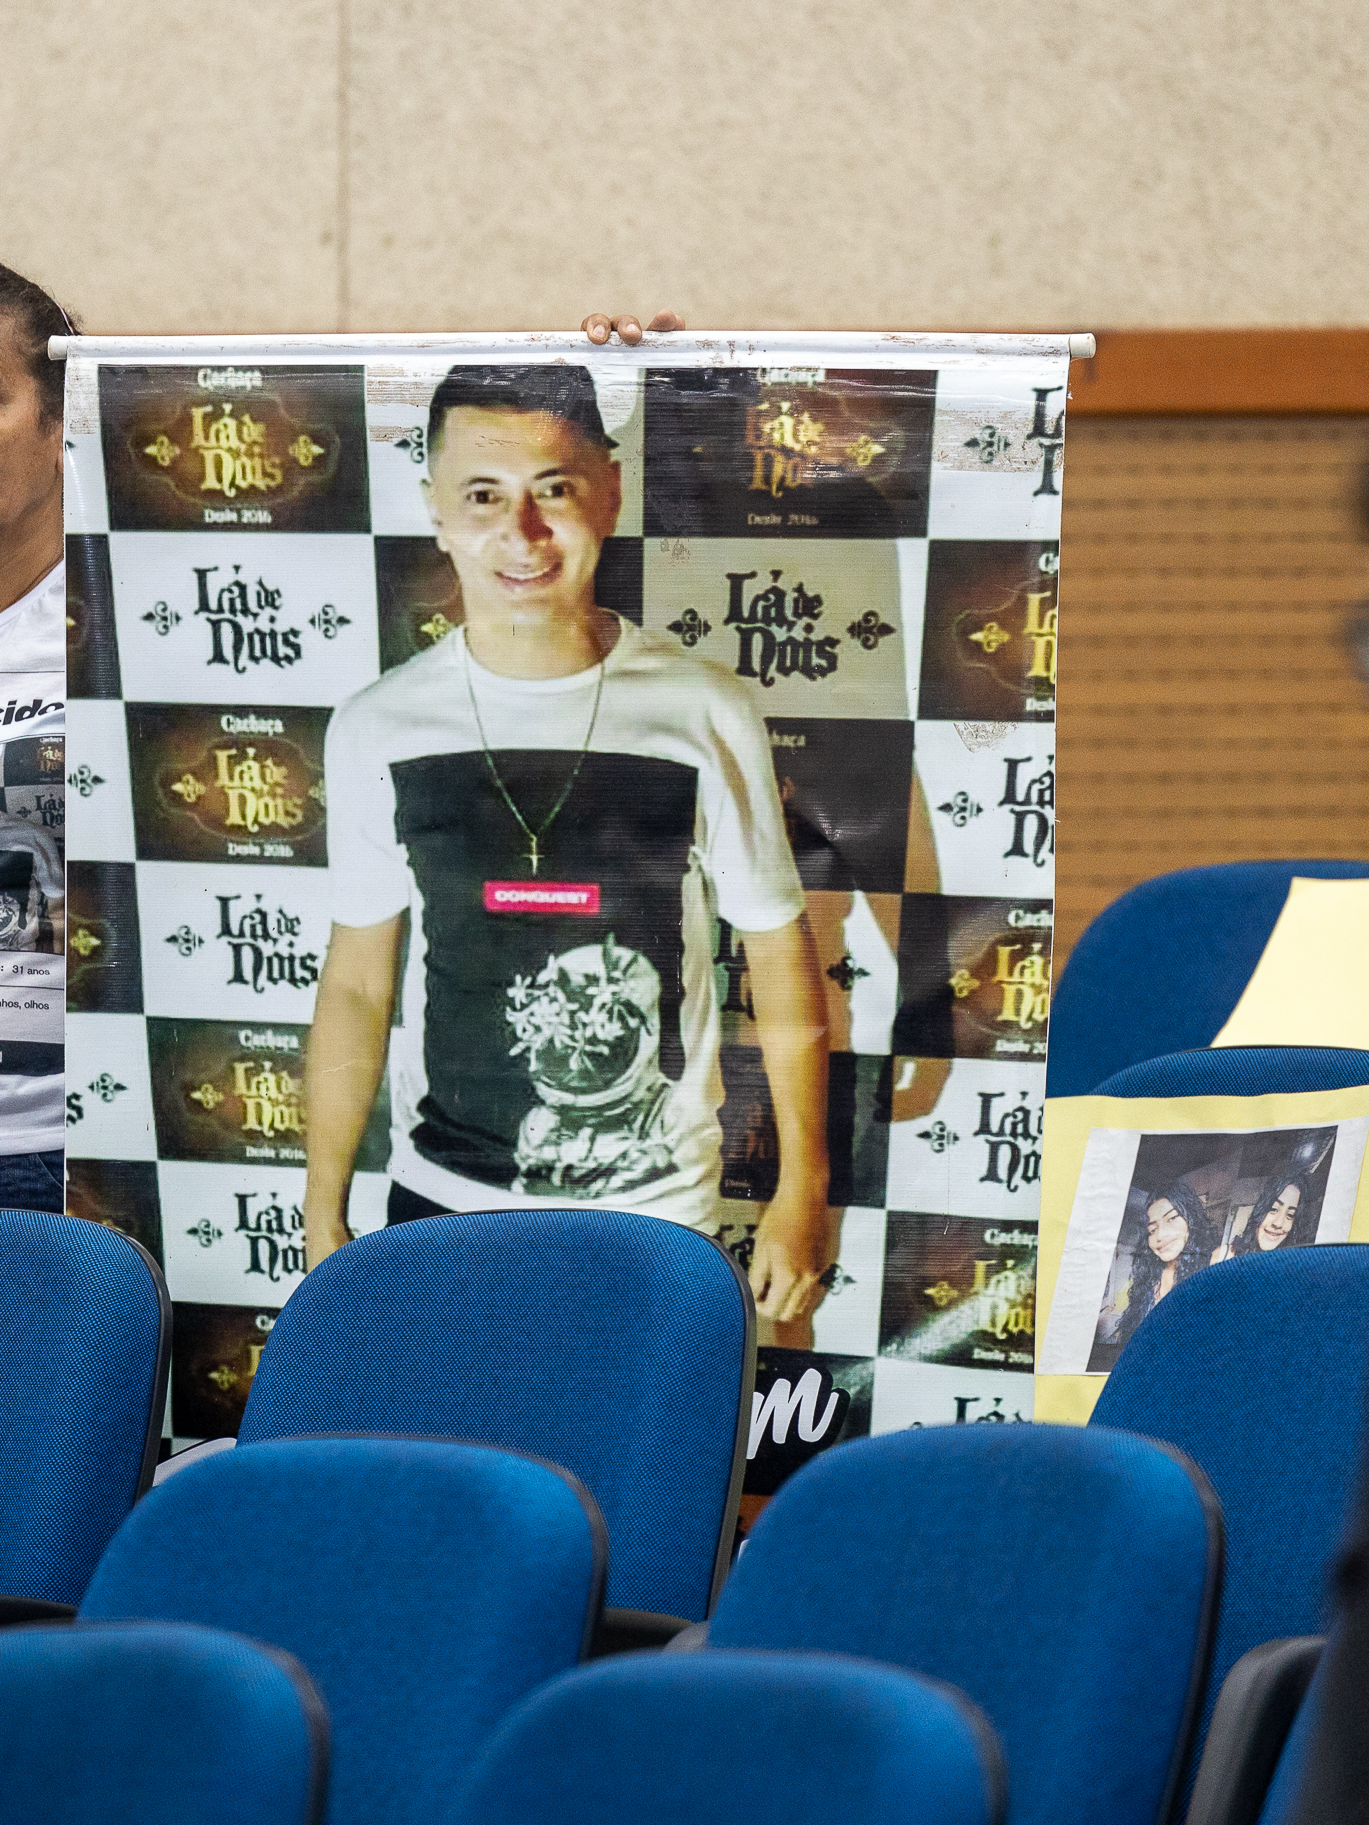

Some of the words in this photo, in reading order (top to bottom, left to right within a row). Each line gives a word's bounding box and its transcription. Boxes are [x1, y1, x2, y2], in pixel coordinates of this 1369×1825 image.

[256, 576, 282, 611] de
[277, 906, 301, 936] de
[12, 965, 24, 974] 31
[27, 968, 51, 976] anos
[24, 1001, 50, 1010] olhos
[995, 984, 1049, 1030] No
[979, 1138, 1041, 1192] No
